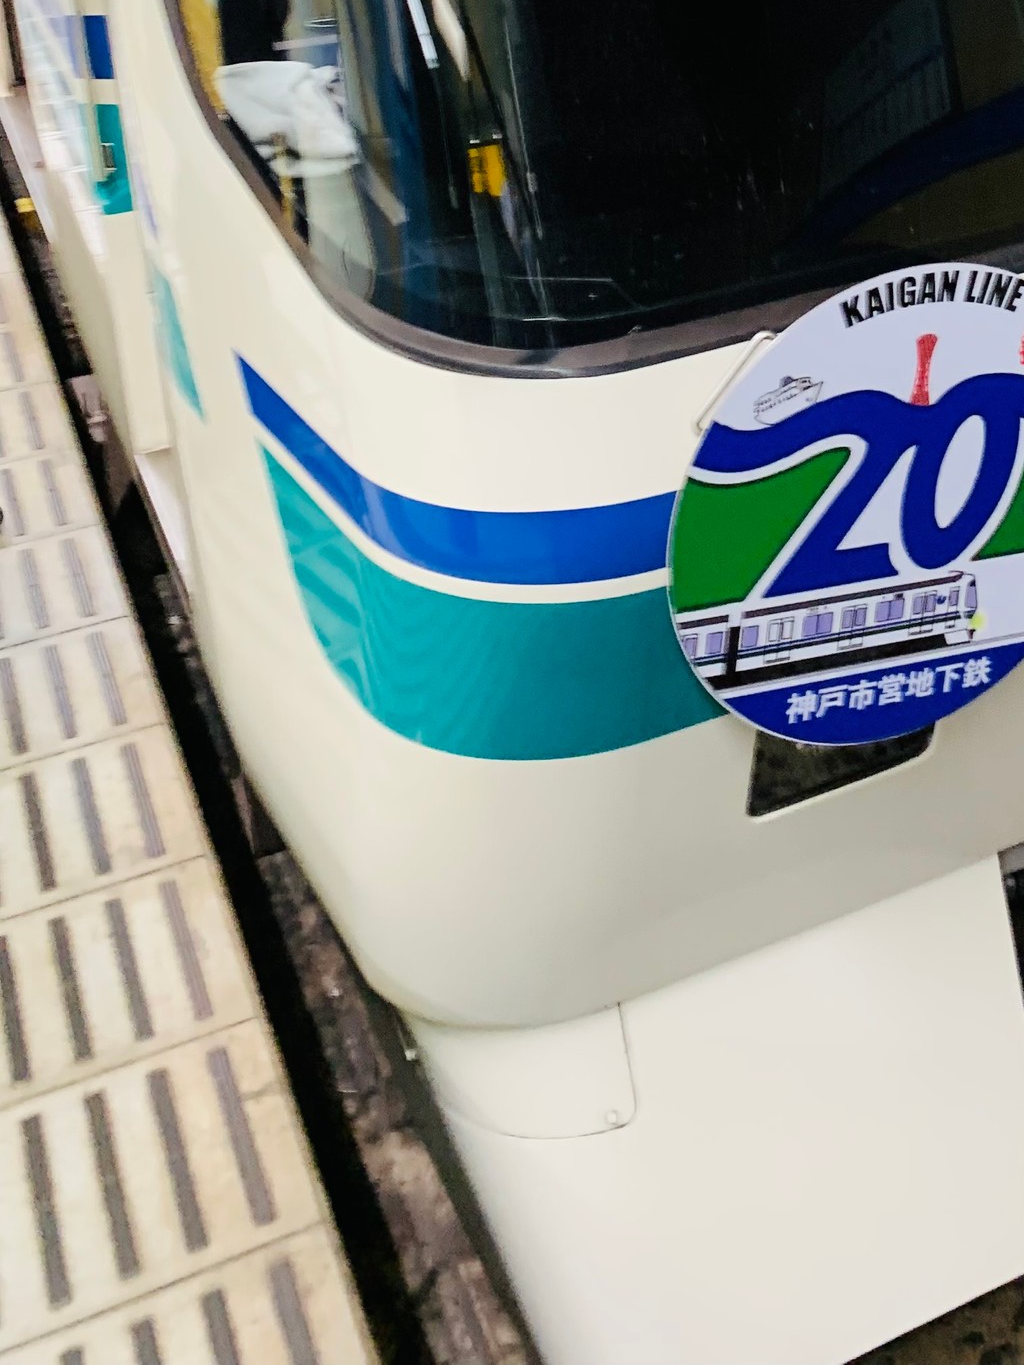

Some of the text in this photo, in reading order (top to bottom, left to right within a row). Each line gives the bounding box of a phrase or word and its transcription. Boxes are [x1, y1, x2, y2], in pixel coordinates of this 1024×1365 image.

[839, 270, 959, 328] KAIGAN
[785, 657, 992, 724] 神戸市営地下鉄
